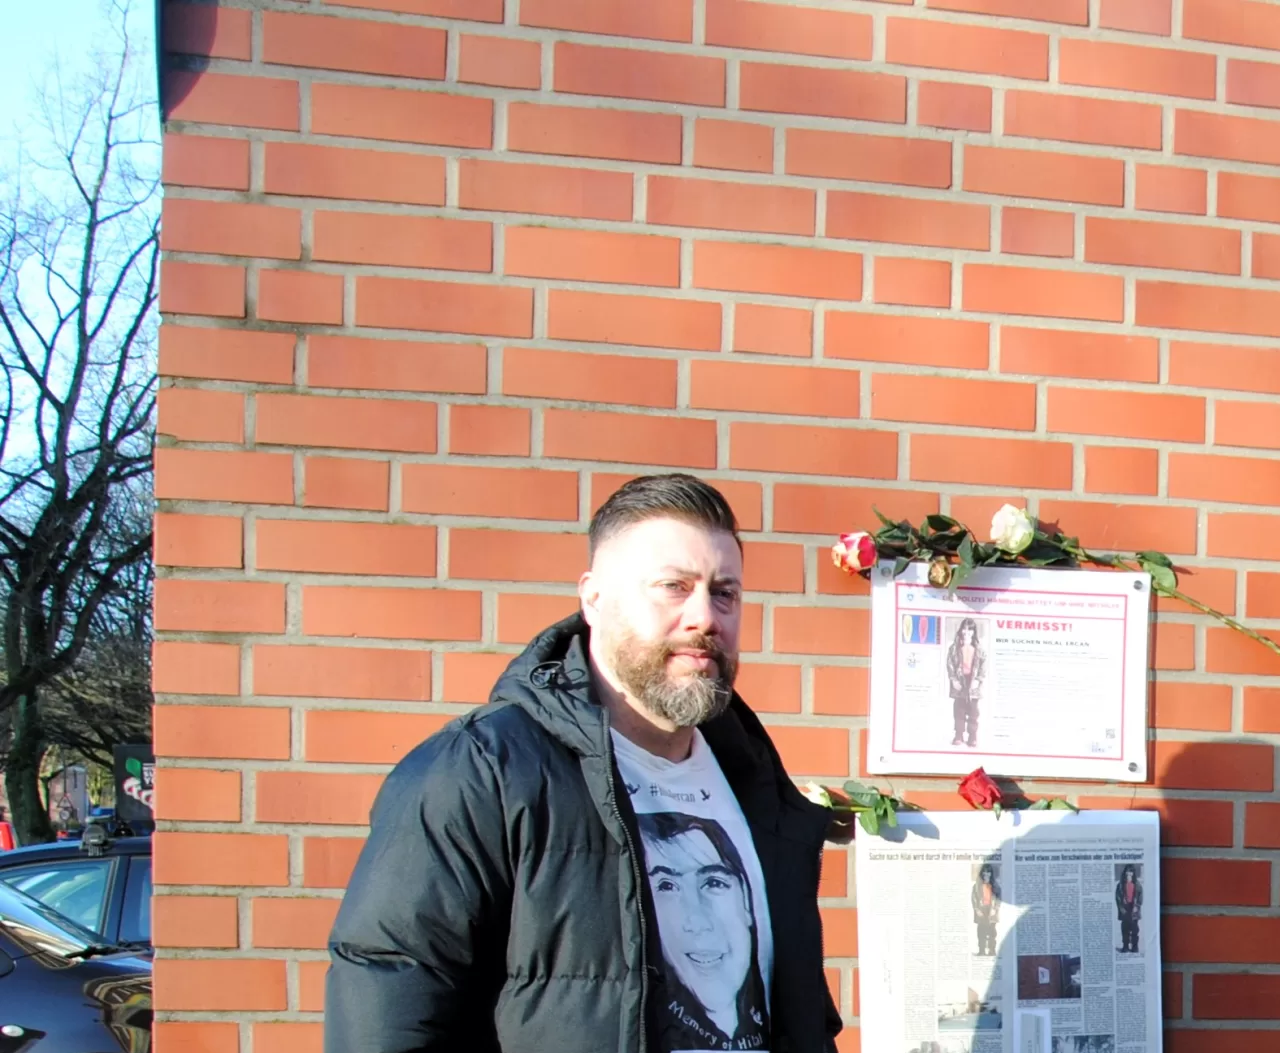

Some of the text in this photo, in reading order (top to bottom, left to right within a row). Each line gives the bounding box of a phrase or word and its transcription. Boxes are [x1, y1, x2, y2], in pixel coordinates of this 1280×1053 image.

[996, 619, 1073, 632] VERMISST!
[668, 1000, 718, 1046] Memory
[722, 1040, 733, 1050] of
